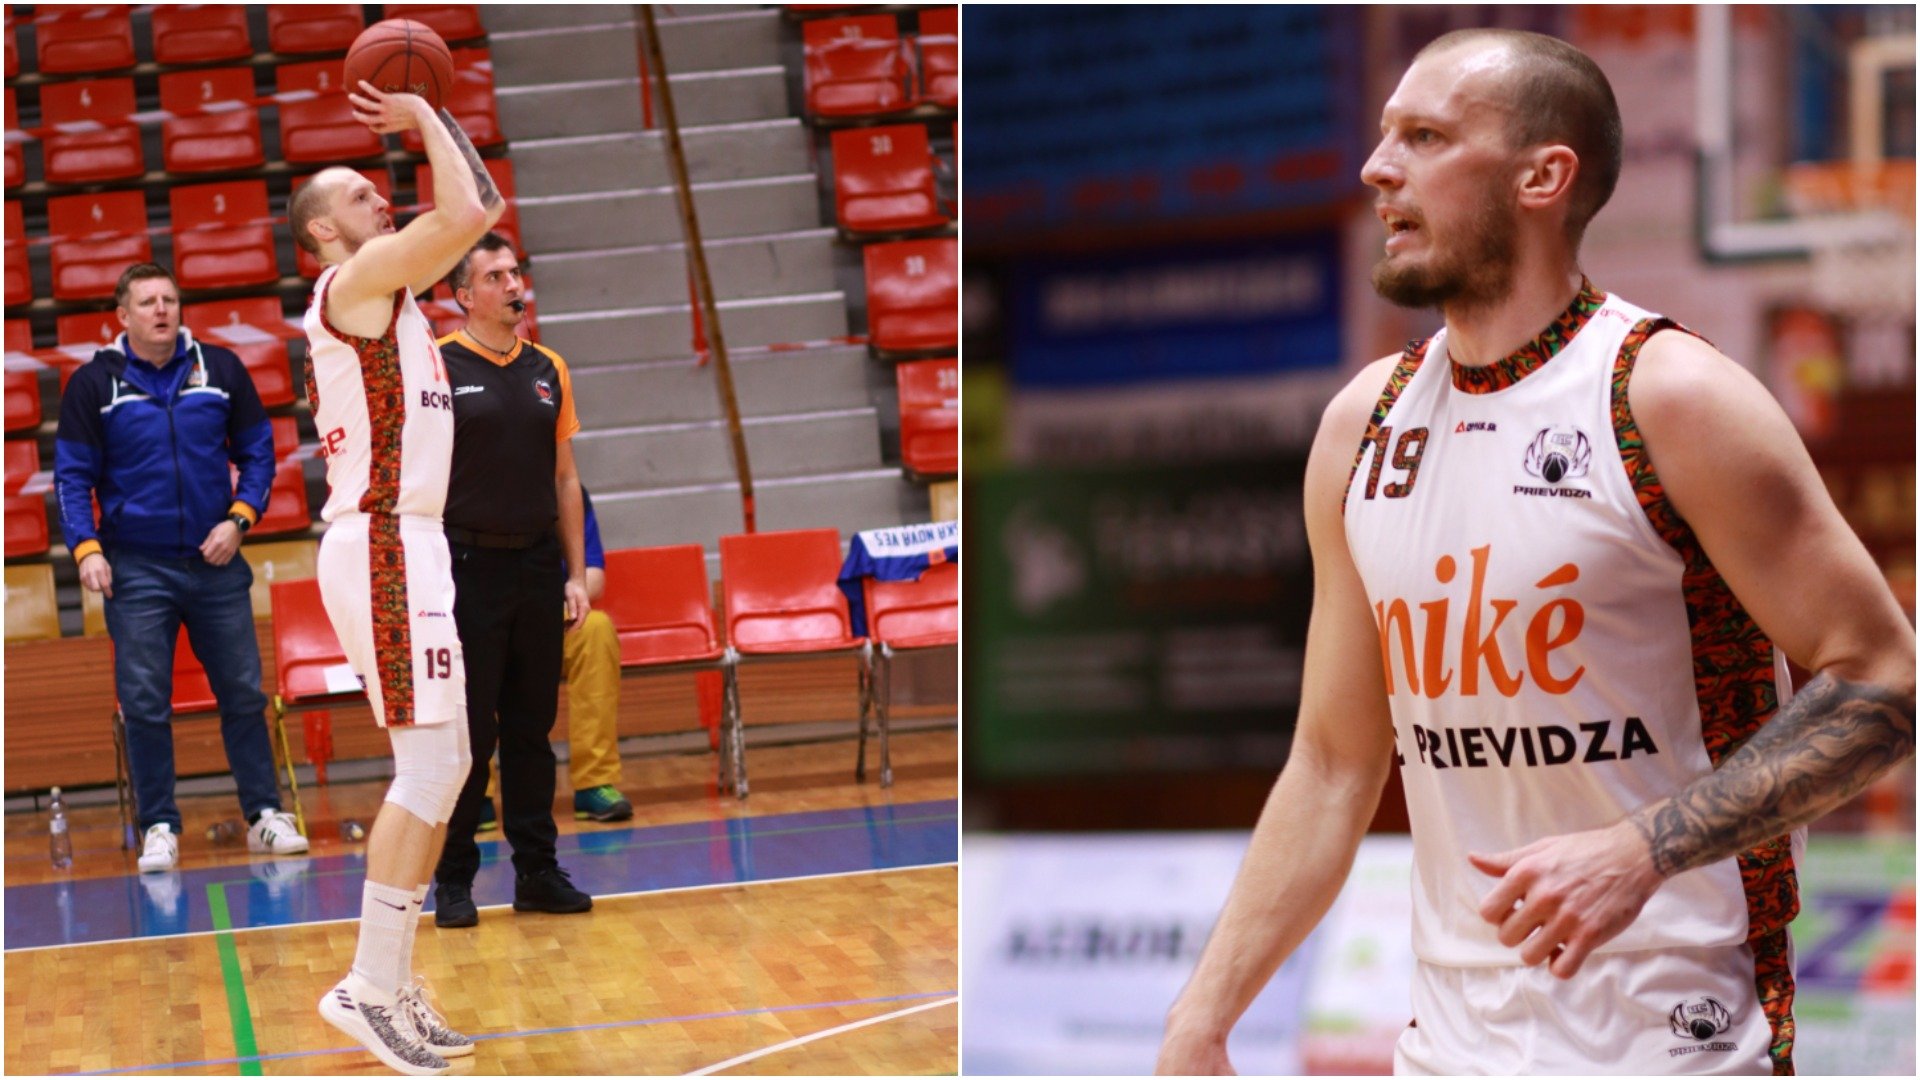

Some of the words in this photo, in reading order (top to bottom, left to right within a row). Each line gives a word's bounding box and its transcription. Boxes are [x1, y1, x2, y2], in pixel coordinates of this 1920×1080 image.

[1363, 426, 1429, 500] 19
[1513, 484, 1592, 499] PRIEVIDZA
[873, 531, 899, 547] VES
[1375, 544, 1585, 699] niké
[425, 648, 451, 679] 19
[1412, 717, 1659, 769] PRIEVIDZA
